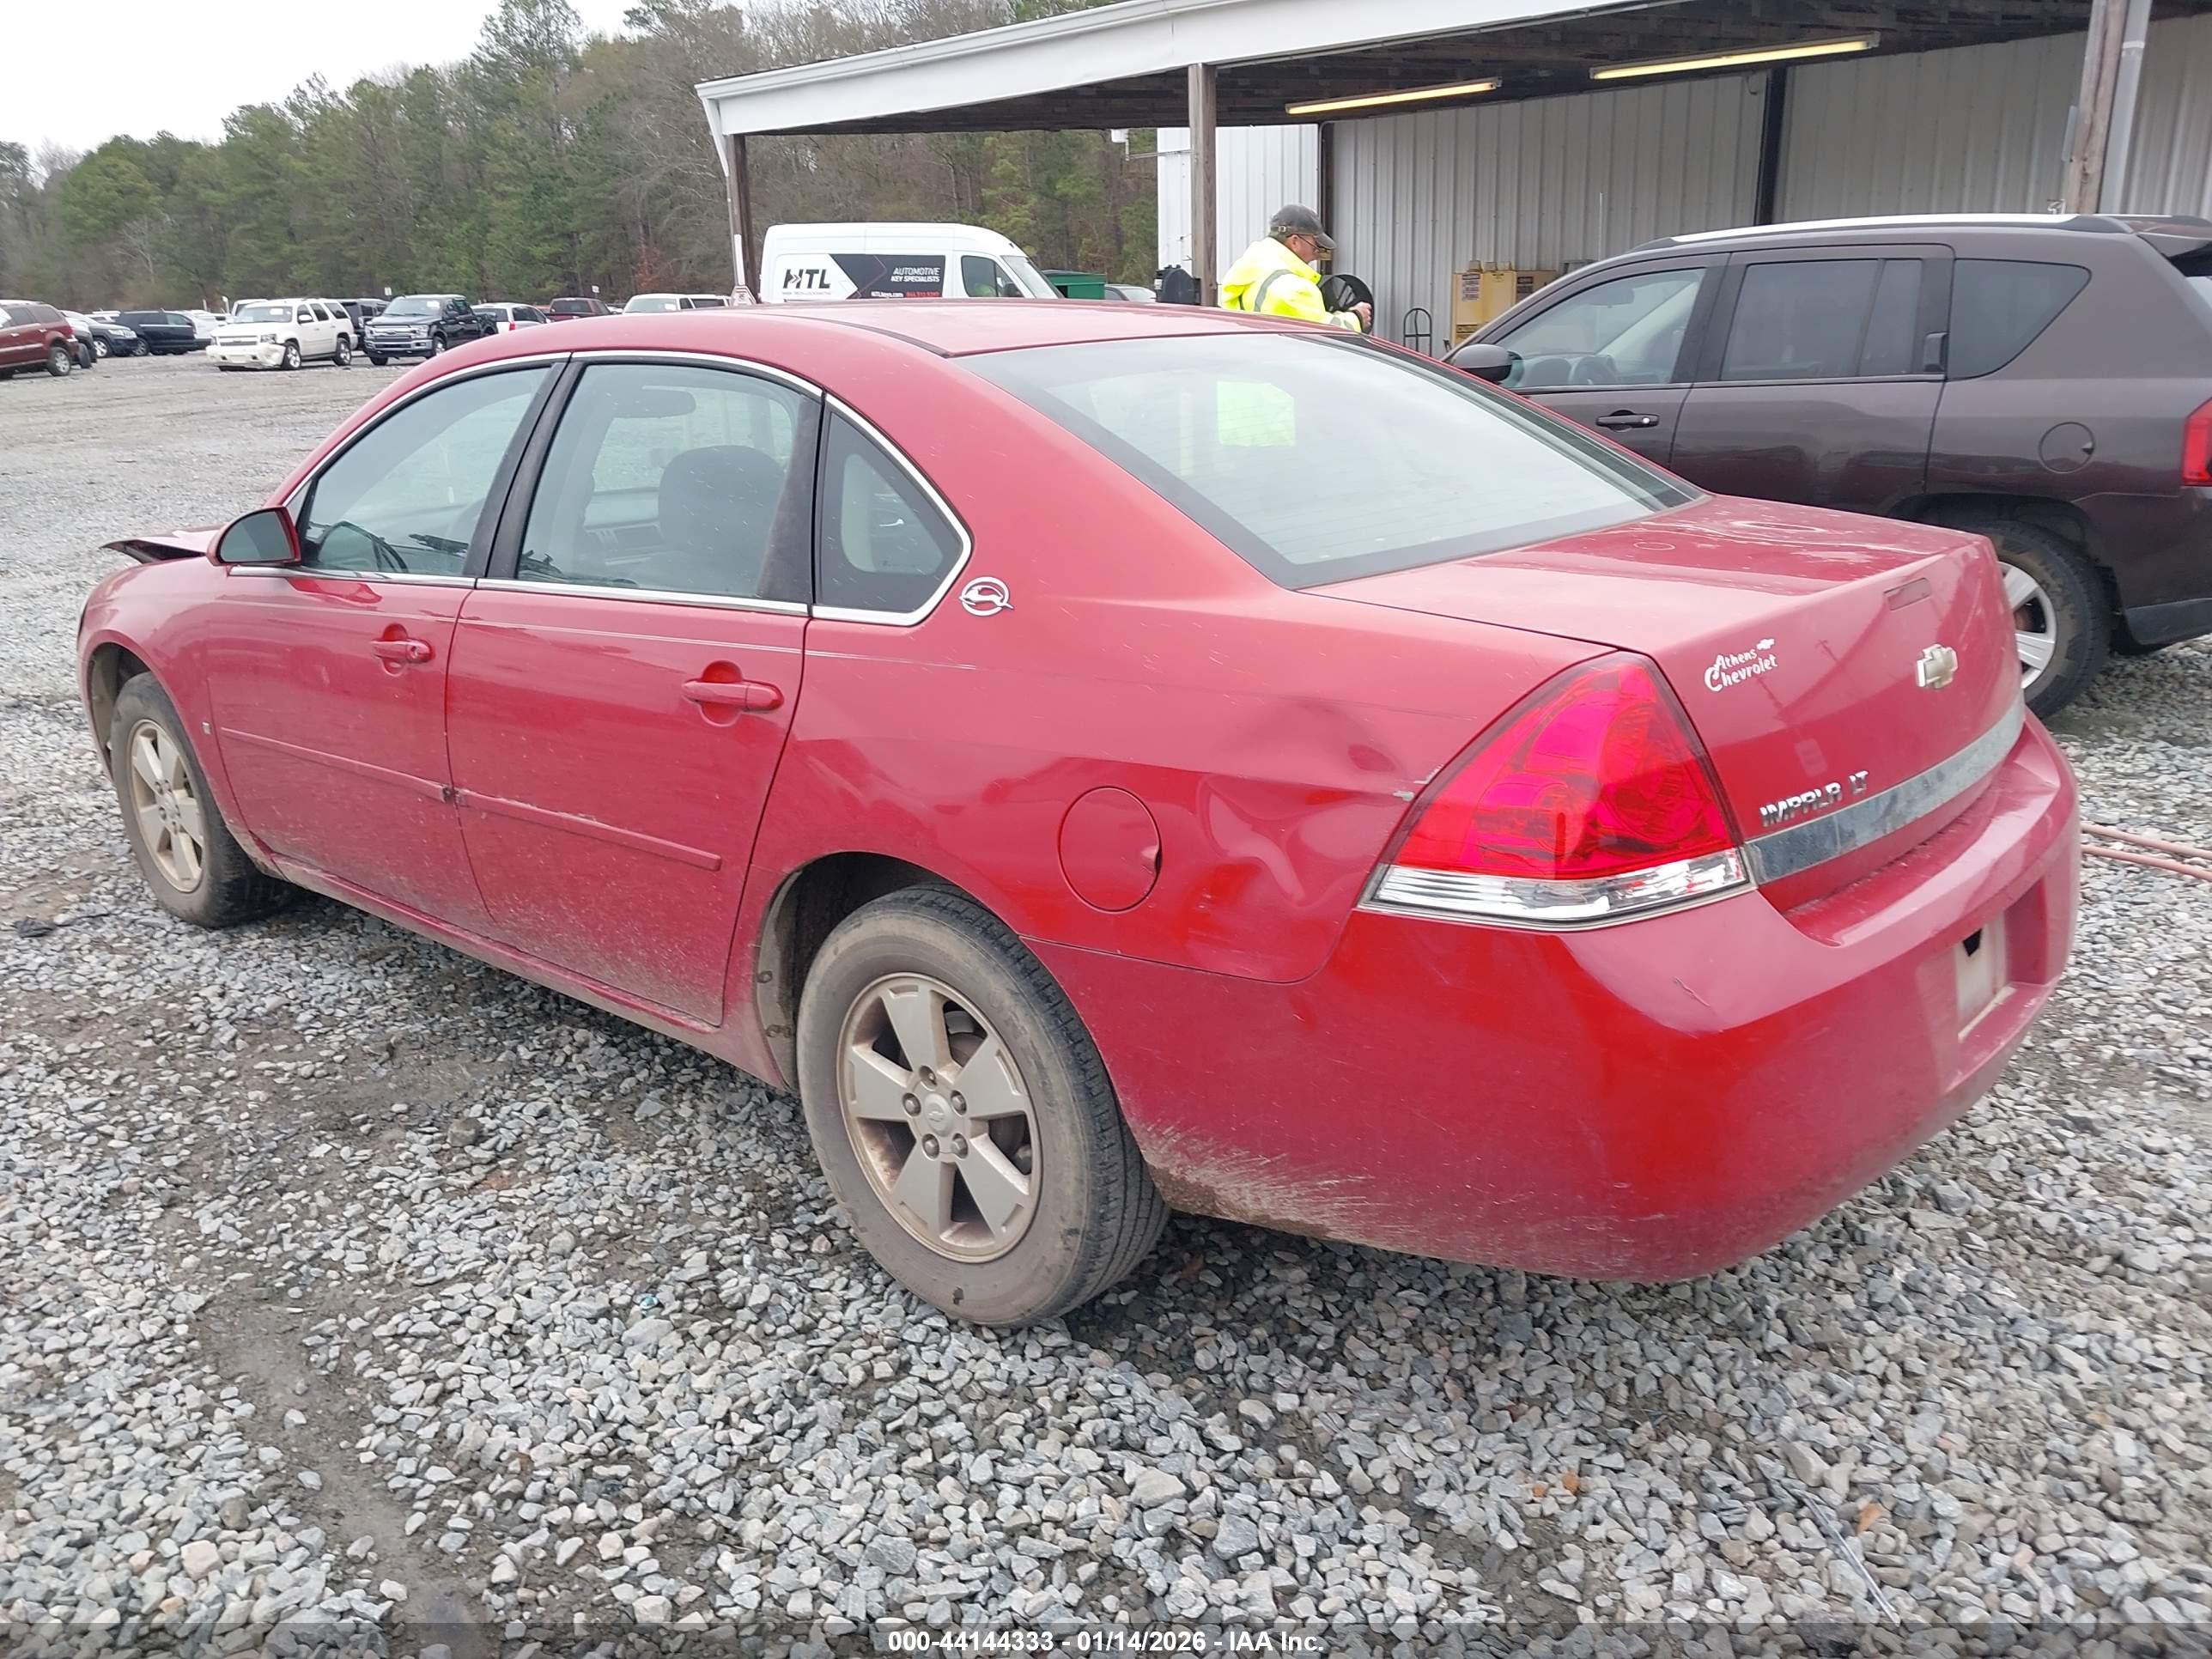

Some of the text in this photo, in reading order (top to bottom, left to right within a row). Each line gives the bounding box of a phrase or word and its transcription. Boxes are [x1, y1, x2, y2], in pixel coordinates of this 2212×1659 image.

[783, 269, 830, 289] HTL
[893, 267, 940, 276] AUTOMOTIVE
[1713, 648, 1757, 670] Athens
[1704, 653, 1778, 692] Chevrolet
[1759, 770, 1869, 827] IMPALA LT
